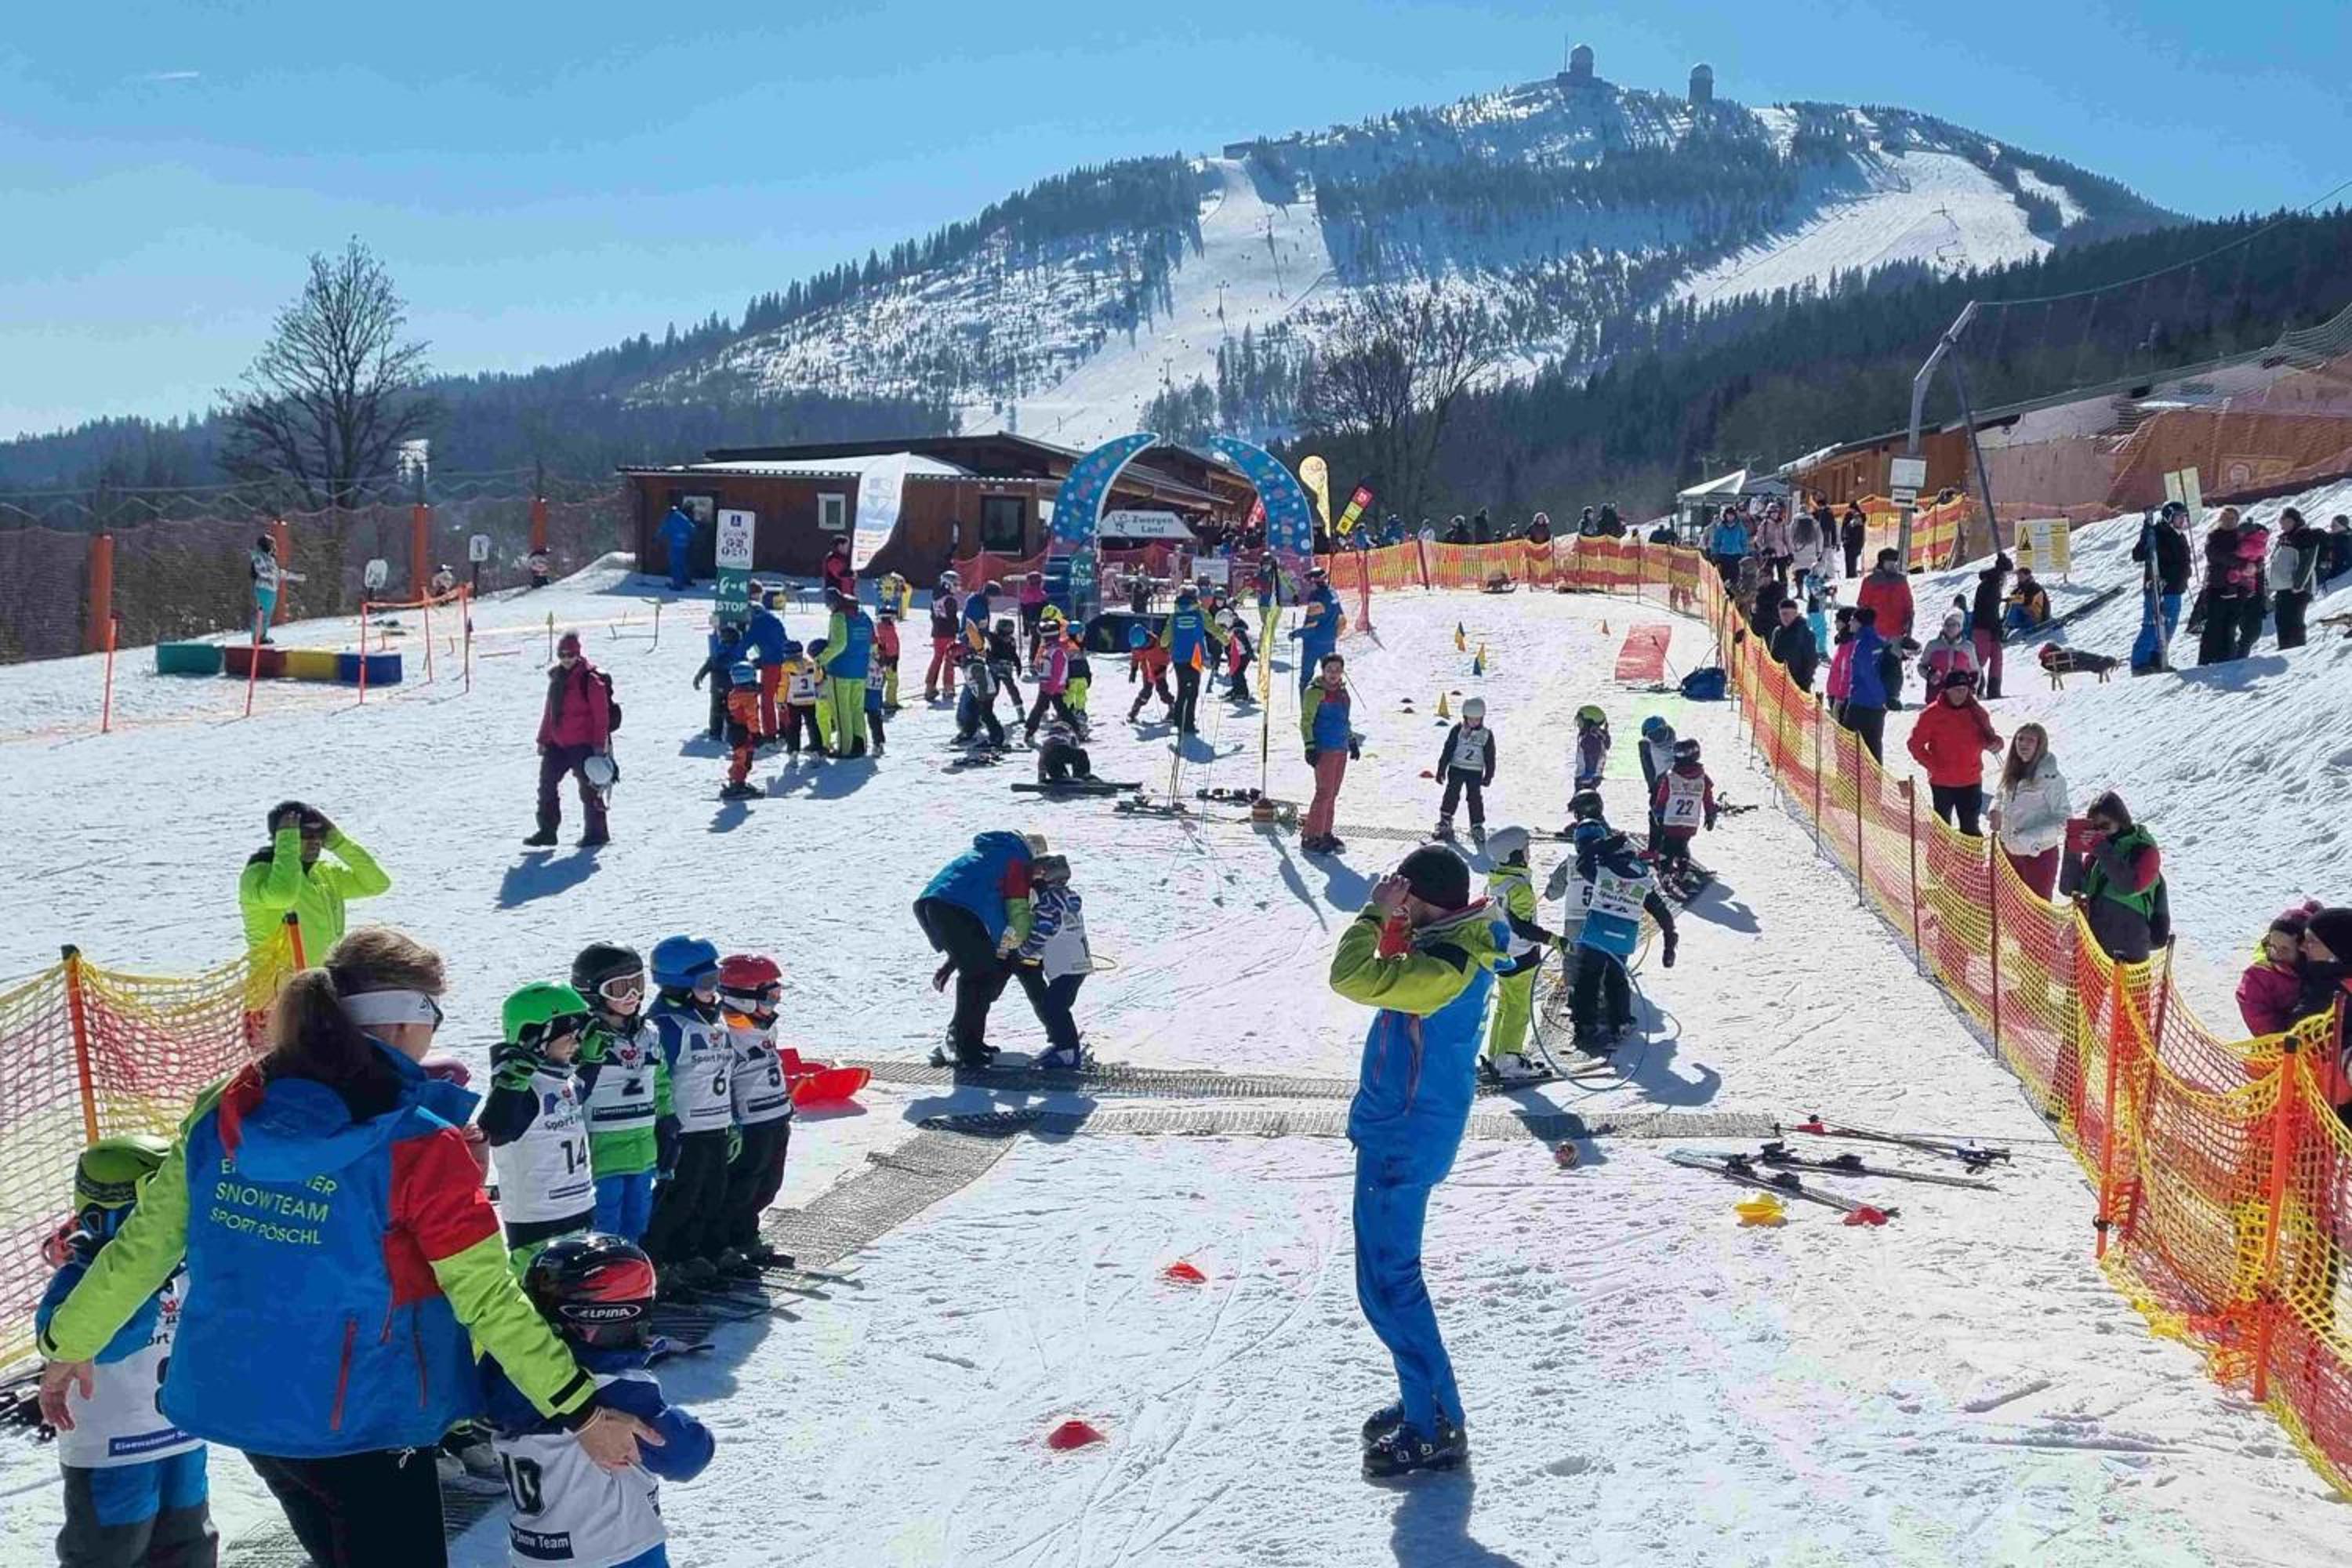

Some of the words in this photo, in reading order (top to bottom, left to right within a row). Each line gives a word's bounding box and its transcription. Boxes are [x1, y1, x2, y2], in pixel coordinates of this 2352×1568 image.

[1141, 525, 1164, 534] Land
[1070, 578, 1092, 586] STOP
[717, 601, 747, 612] STOP
[800, 677, 808, 690] 3
[1465, 749, 1475, 761] 2
[1676, 799, 1694, 815] 22
[1582, 885, 1593, 907] 5
[713, 1069, 727, 1096] 6
[544, 1116, 574, 1131] Sport
[560, 1135, 588, 1175] 14
[216, 1181, 329, 1223] SNOWTEAM
[210, 1207, 260, 1234] SPORT
[257, 1223, 323, 1245] PÖSCHL
[579, 1308, 630, 1319] ALPINA
[538, 1534, 569, 1549] Team
